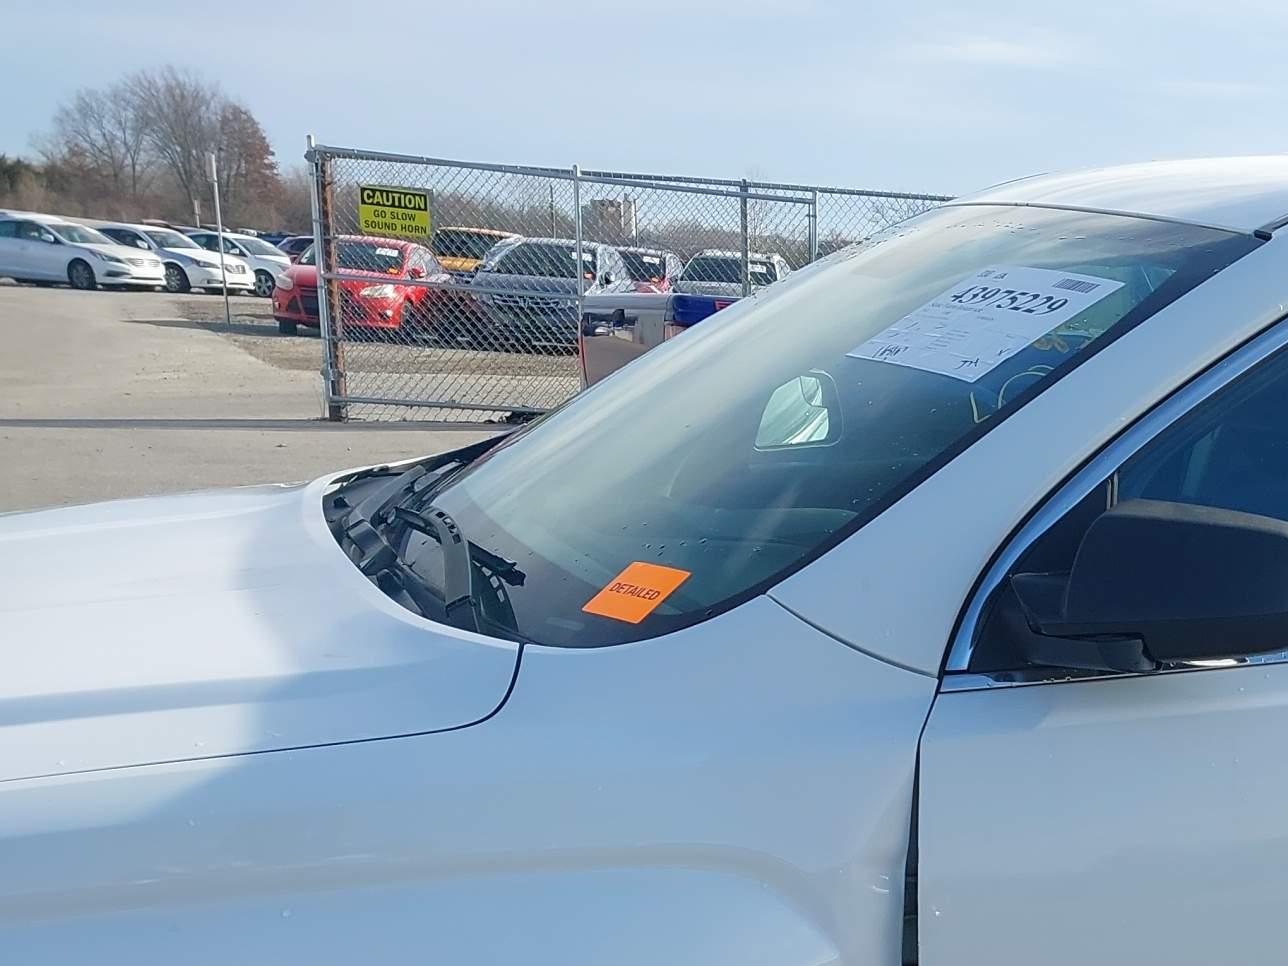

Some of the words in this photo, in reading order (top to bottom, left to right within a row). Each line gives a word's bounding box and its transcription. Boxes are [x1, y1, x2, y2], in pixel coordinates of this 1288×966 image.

[363, 189, 425, 210] CAUTION
[373, 209, 387, 219] GO
[390, 211, 417, 222] SLOW
[364, 219, 397, 232] SOUND
[400, 223, 427, 235] HORN
[951, 285, 1069, 316] 43975229
[609, 582, 662, 601] DETAILED
